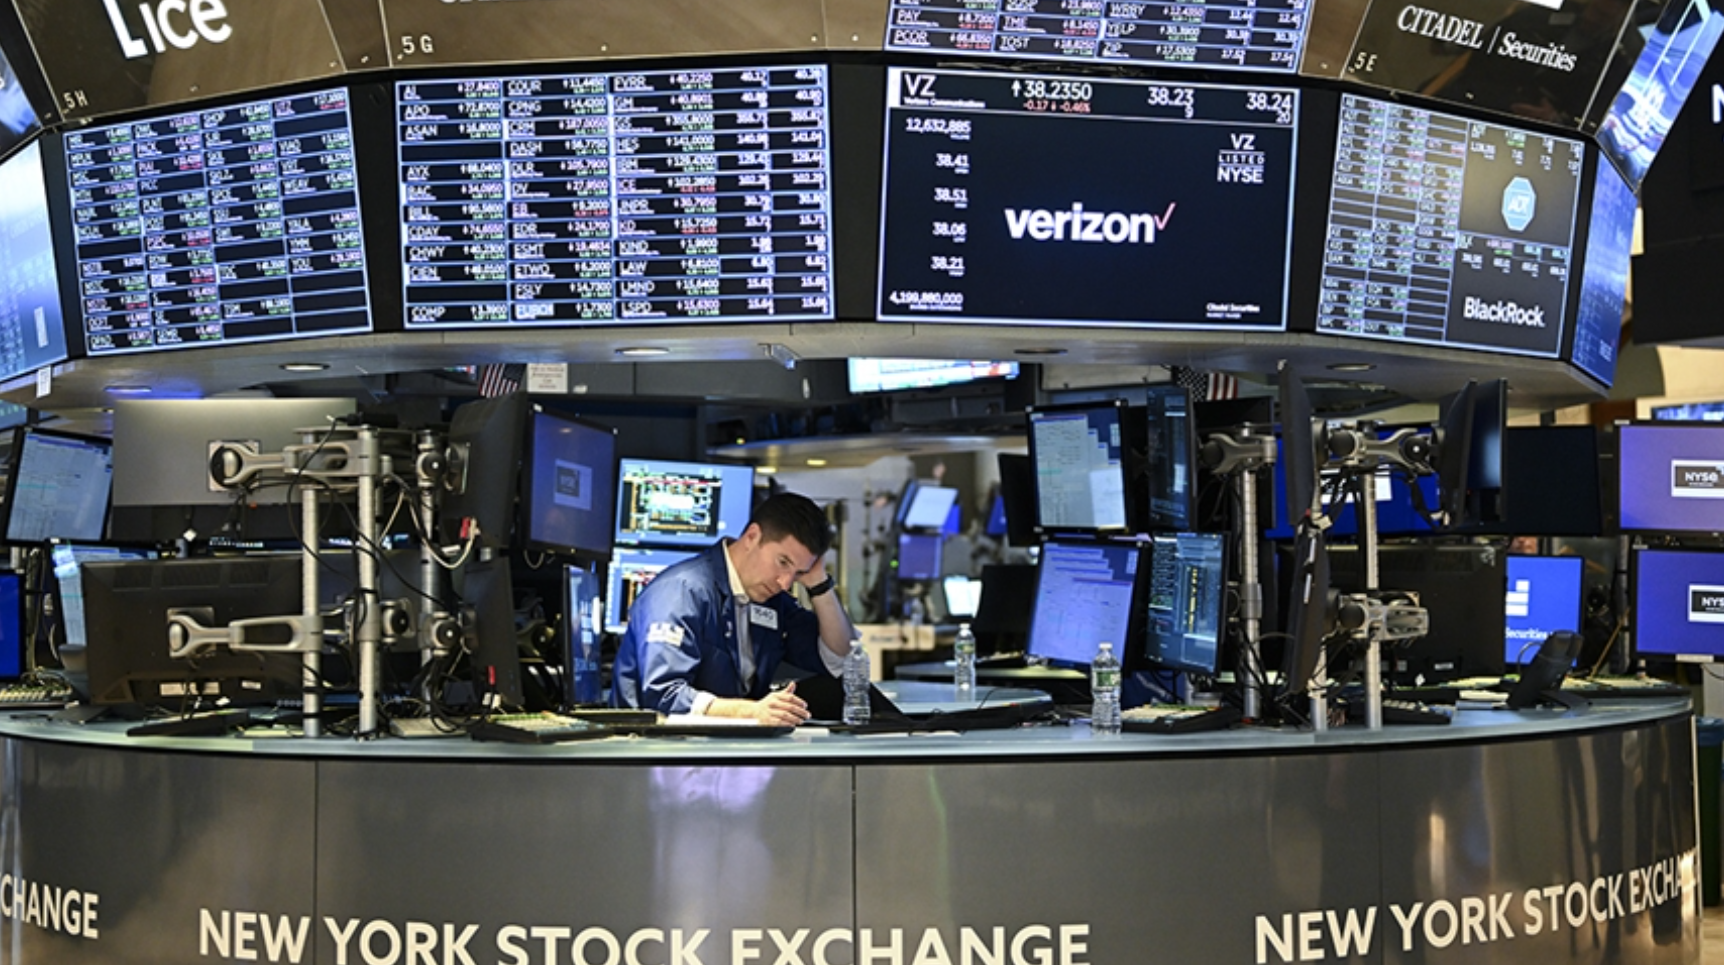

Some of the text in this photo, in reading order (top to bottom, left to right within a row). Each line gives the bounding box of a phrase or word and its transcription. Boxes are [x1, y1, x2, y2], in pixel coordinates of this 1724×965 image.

[898, 10, 921, 22] PAY
[1003, 17, 1028, 28] TME
[1108, 23, 1136, 34] YELP
[895, 30, 927, 42] PCOR
[1001, 36, 1030, 48] TOST
[1397, 4, 1578, 72] CITADEL Securities
[508, 79, 542, 92] COUR
[904, 74, 1292, 111] VZ 38.2350 38.23 38.24
[508, 100, 542, 112] CPNG
[614, 97, 634, 108] GM
[1023, 100, 1048, 111] -0.17
[405, 104, 430, 116] APO
[1184, 105, 1194, 119] 9
[1275, 110, 1291, 124] 20
[405, 124, 438, 136] ASAN
[509, 120, 536, 132] CRM
[905, 117, 971, 133] 12,632,885
[510, 141, 542, 153] DASH
[616, 137, 640, 149] HES
[1230, 133, 1255, 150] VZ
[935, 153, 970, 167] 38.41
[1218, 154, 1265, 165] LISTED
[407, 165, 430, 177] AYX
[511, 161, 535, 173] DLR
[1217, 167, 1264, 184] NYSE
[513, 223, 537, 234] EDR
[619, 220, 636, 231] KD
[1005, 202, 1155, 243] verizon
[409, 225, 440, 237] CDAY
[932, 222, 966, 236] 38.06
[409, 246, 446, 257] CHWY
[513, 243, 545, 255] ESMT
[619, 240, 649, 252] KIND
[514, 263, 550, 275] ETWO
[620, 260, 647, 271] LAW
[930, 256, 965, 270] 38.21
[515, 283, 543, 295] FSLY
[621, 280, 655, 292] LMND
[411, 306, 446, 318] COMP
[621, 302, 651, 313] LSPD
[0, 873, 99, 939] CHANGE
[1255, 906, 1377, 964] NEW
[1390, 892, 1515, 951] YORK
[1523, 872, 1626, 936] STOCK
[199, 907, 1089, 965] NEW YORK STOCK EXCHANGE
